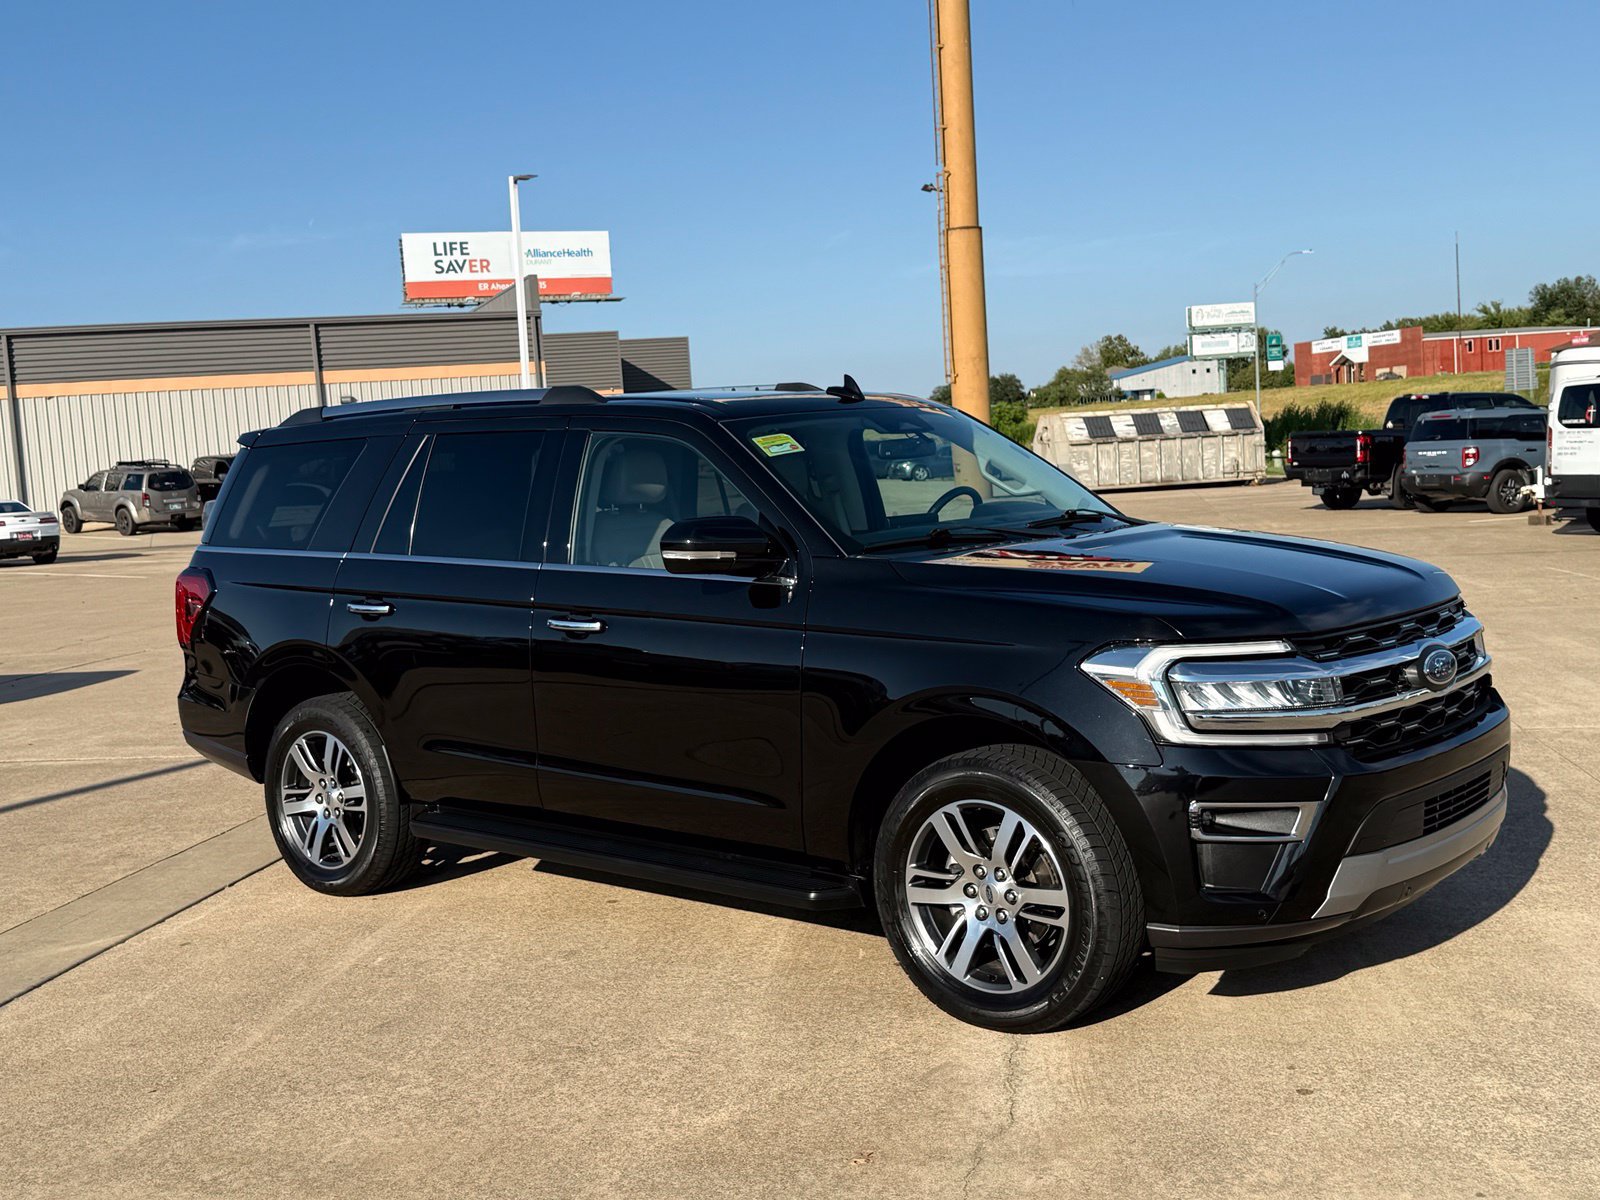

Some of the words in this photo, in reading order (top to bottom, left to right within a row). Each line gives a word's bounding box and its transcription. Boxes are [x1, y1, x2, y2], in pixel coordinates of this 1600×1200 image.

[433, 241, 470, 256] LIFE
[525, 247, 593, 258] AllianceHealth
[434, 258, 491, 275] SAVER
[478, 282, 489, 291] ER
